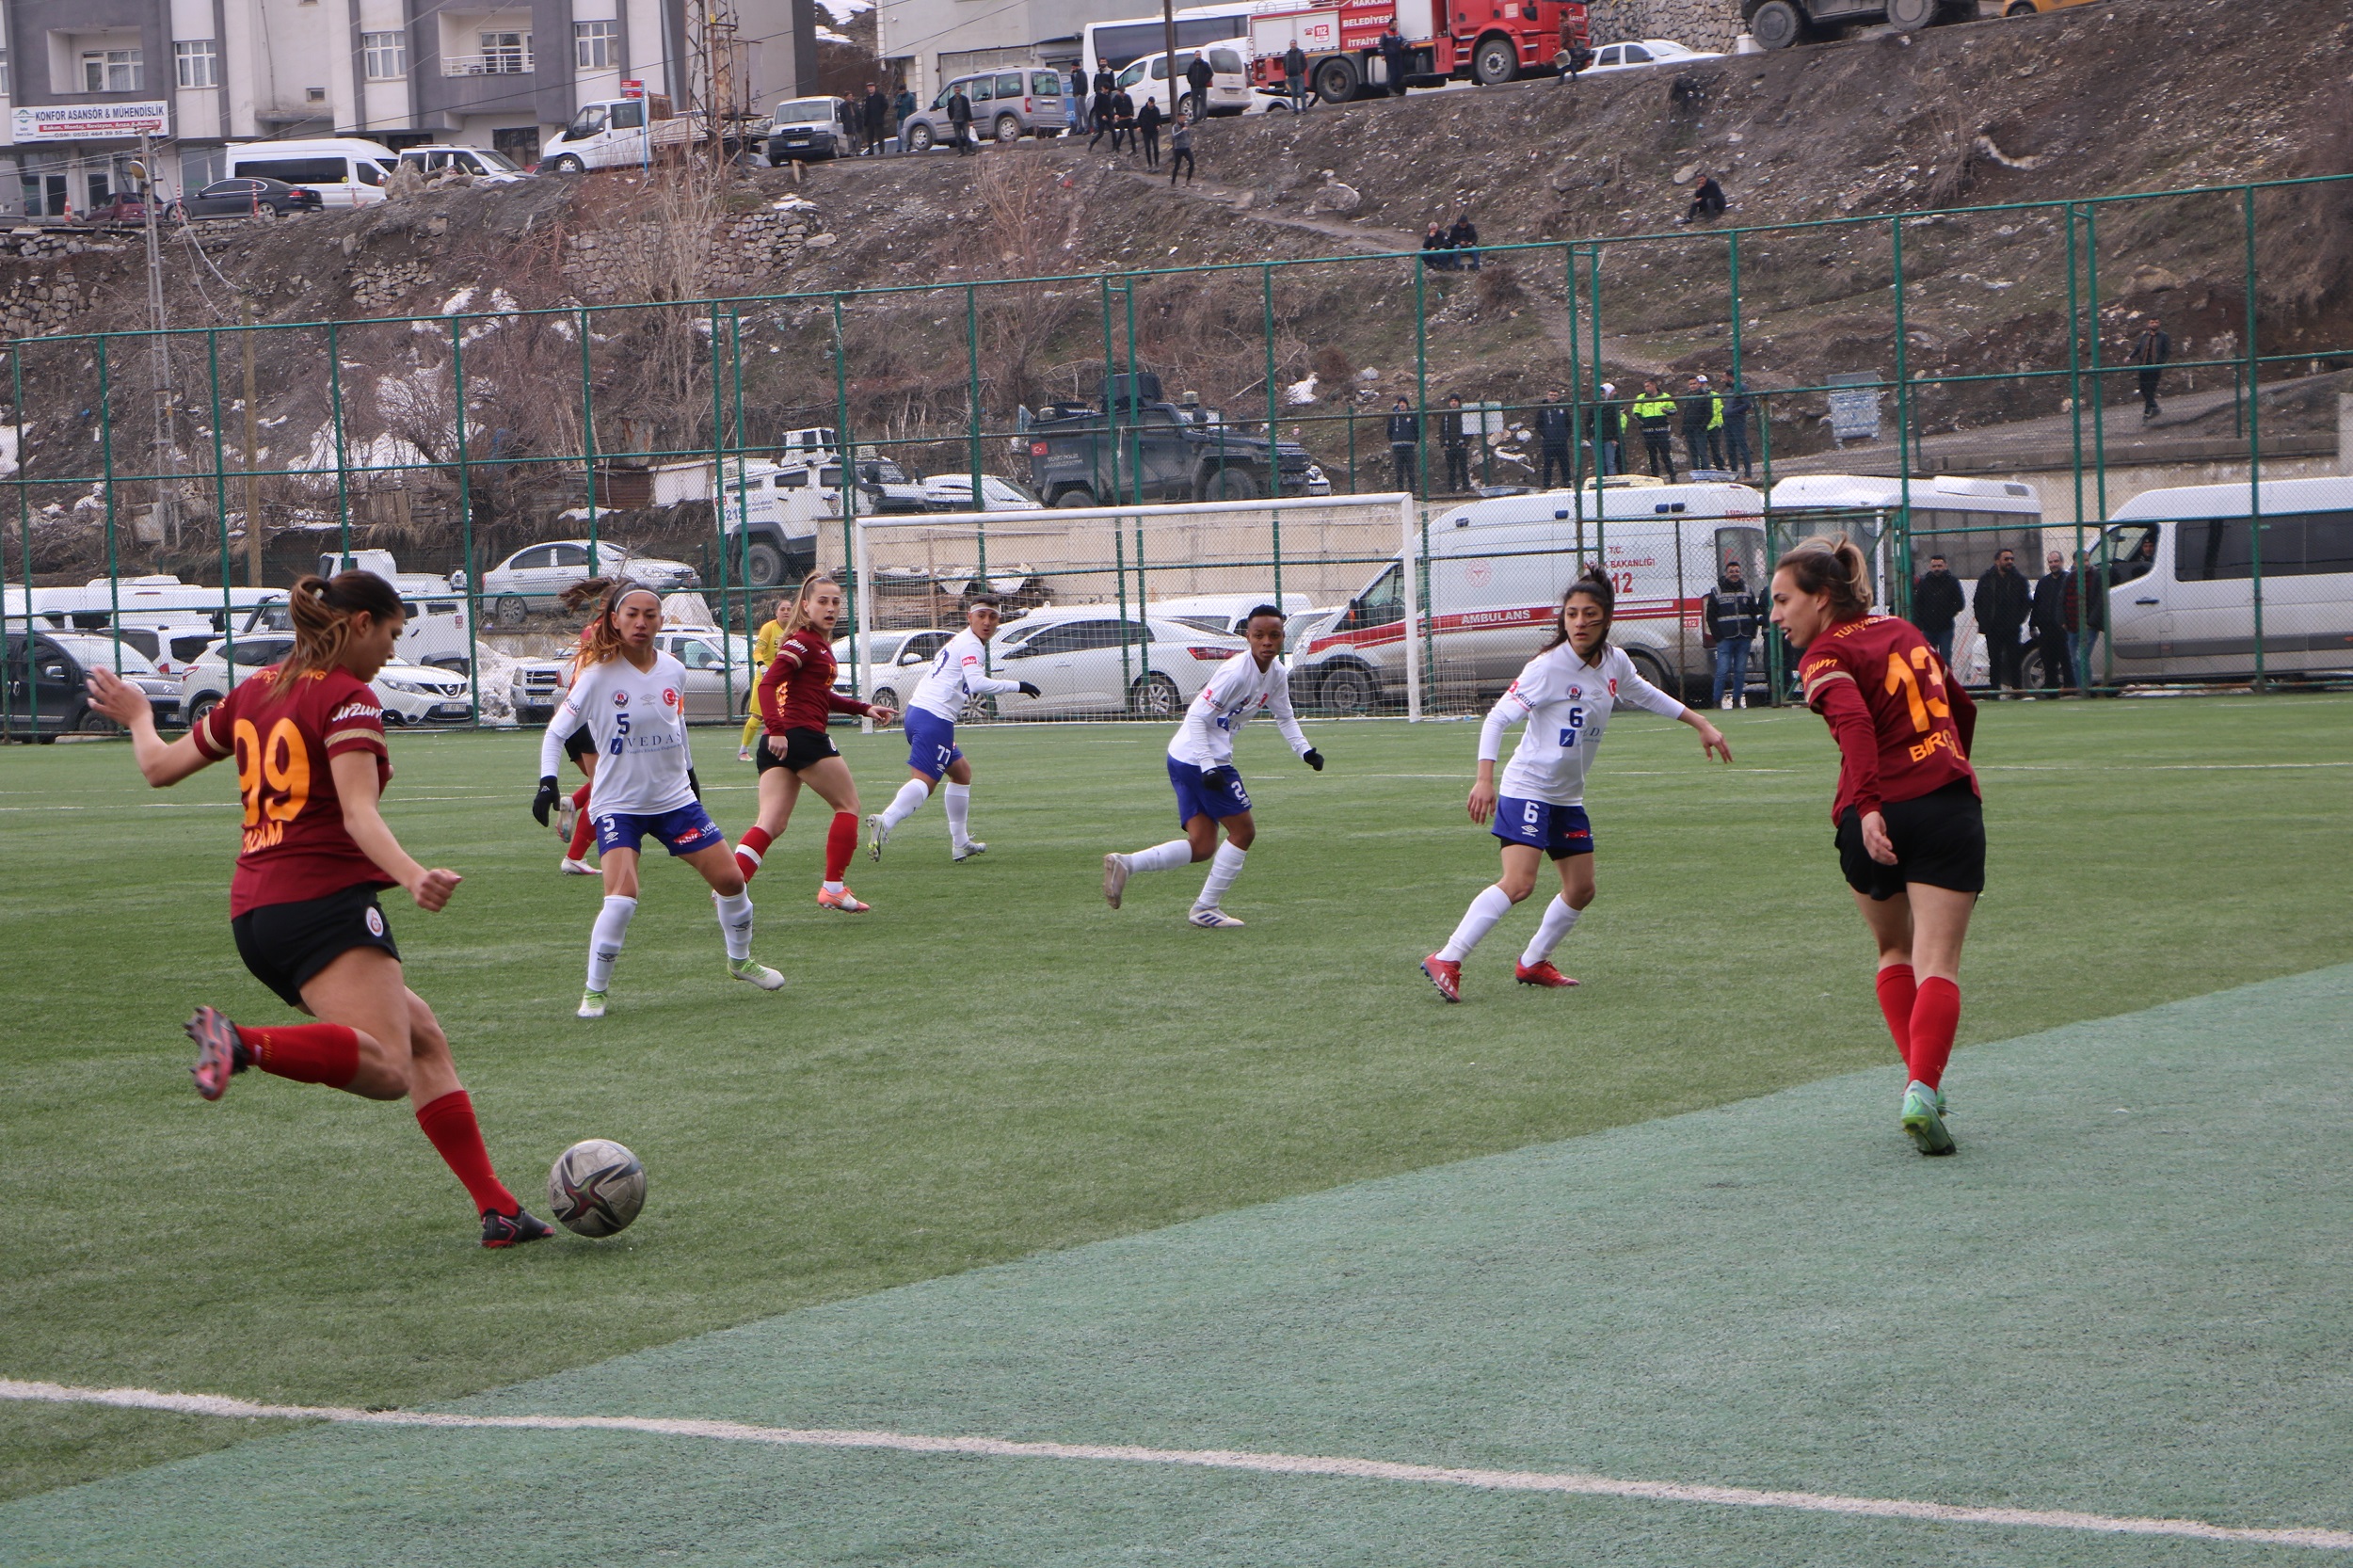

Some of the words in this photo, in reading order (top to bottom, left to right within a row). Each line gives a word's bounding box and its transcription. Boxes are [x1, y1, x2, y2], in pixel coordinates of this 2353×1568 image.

[1343, 13, 1393, 27] BELEDİYESİ
[1316, 26, 1328, 36] 112
[35, 110, 66, 121] KONFOR
[68, 106, 103, 120] ASANSÖR
[105, 108, 111, 119] &
[113, 104, 165, 119] MÜHENDİSLİK
[1609, 546, 1625, 554] T.C.
[1611, 571, 1634, 594] 12
[1461, 609, 1531, 625] AMBULANS
[1885, 646, 1949, 733] 13
[616, 713, 630, 735] 5
[1569, 707, 1583, 728] 6
[937, 744, 952, 764] 77
[234, 717, 310, 826] 99
[1231, 780, 1246, 800] 2
[1523, 801, 1540, 824] 6
[601, 814, 616, 832] 5
